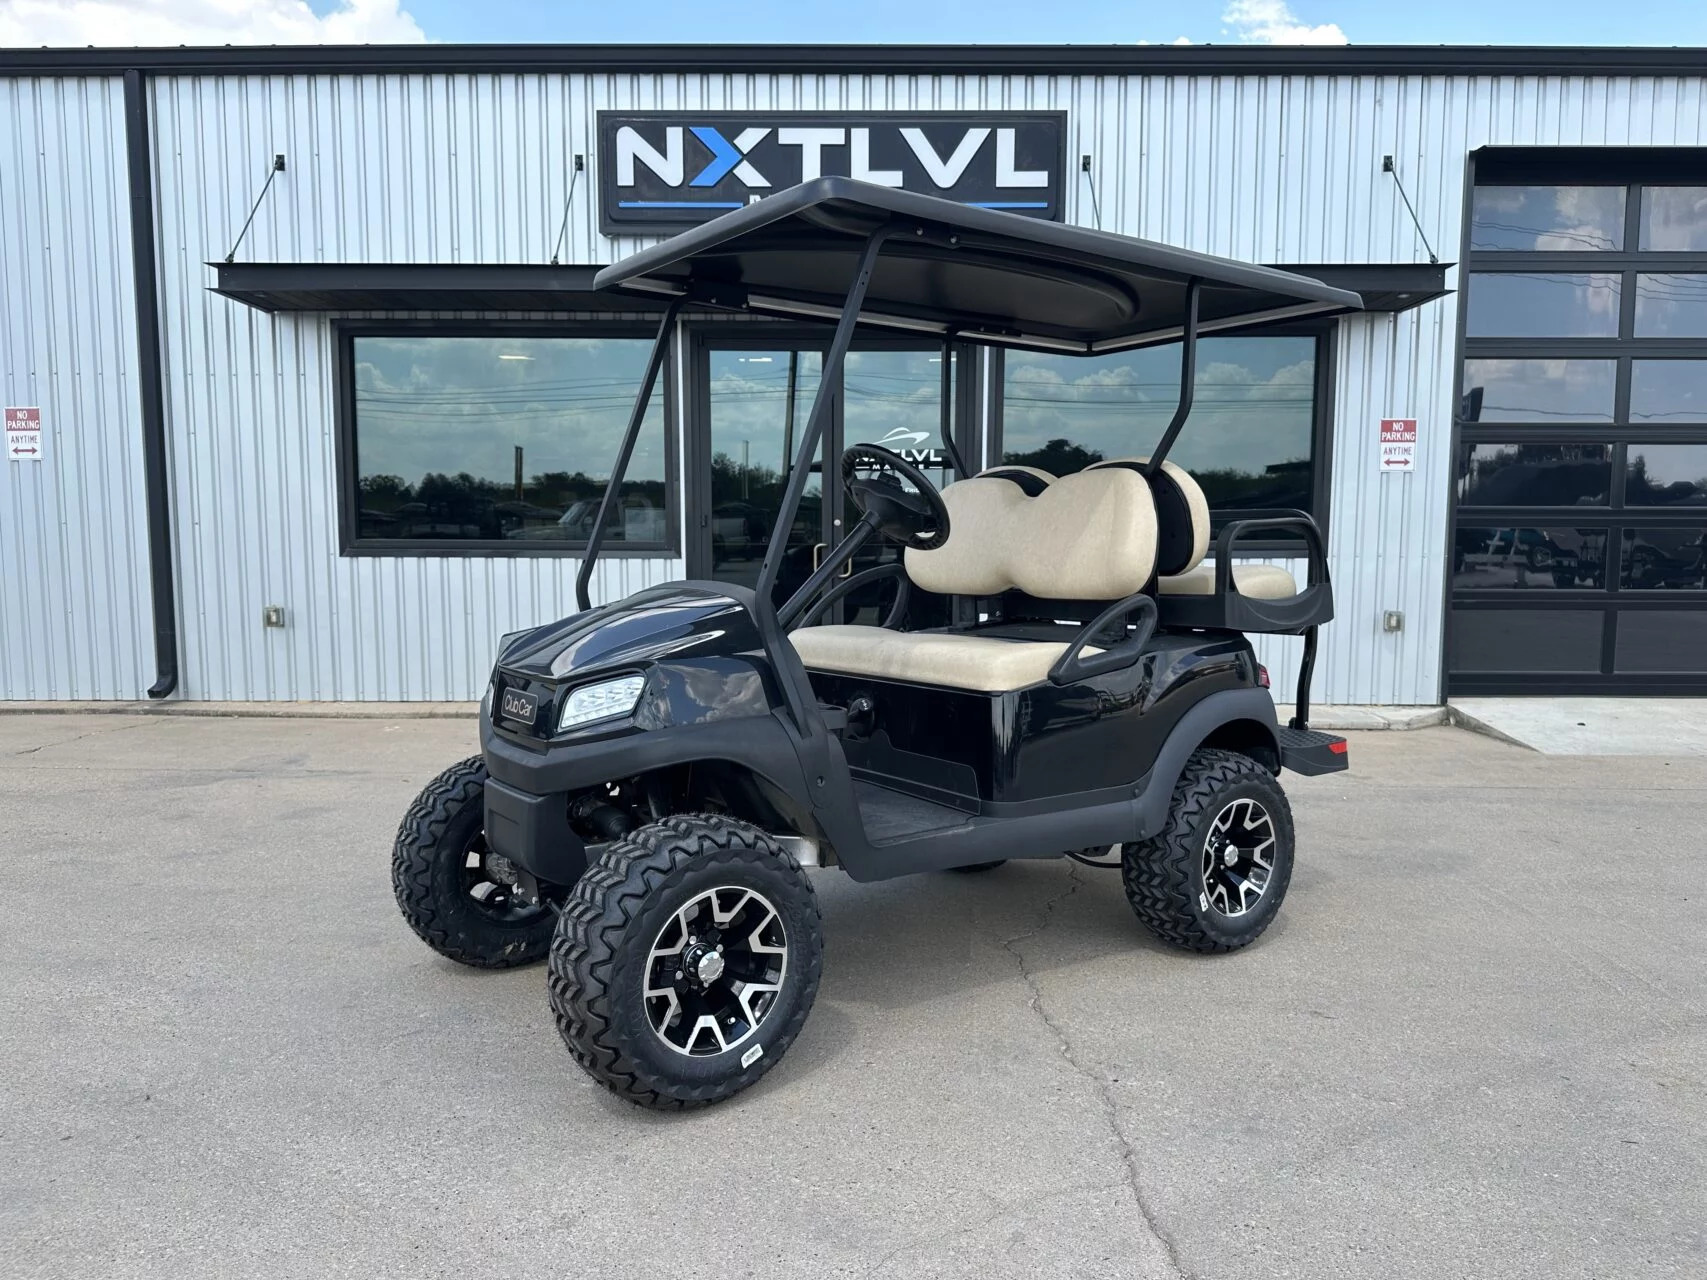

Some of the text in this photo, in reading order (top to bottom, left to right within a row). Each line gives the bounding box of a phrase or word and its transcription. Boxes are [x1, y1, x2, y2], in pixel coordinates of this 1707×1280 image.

[616, 126, 1049, 188] NXTLVL
[16, 410, 28, 420] NO
[7, 420, 40, 430] PARKING
[1392, 421, 1404, 431] NO
[11, 435, 38, 444] ANYTIME
[1381, 431, 1416, 441] PARKING
[1383, 446, 1412, 456] ANYTIME
[504, 694, 533, 717] Club Car
